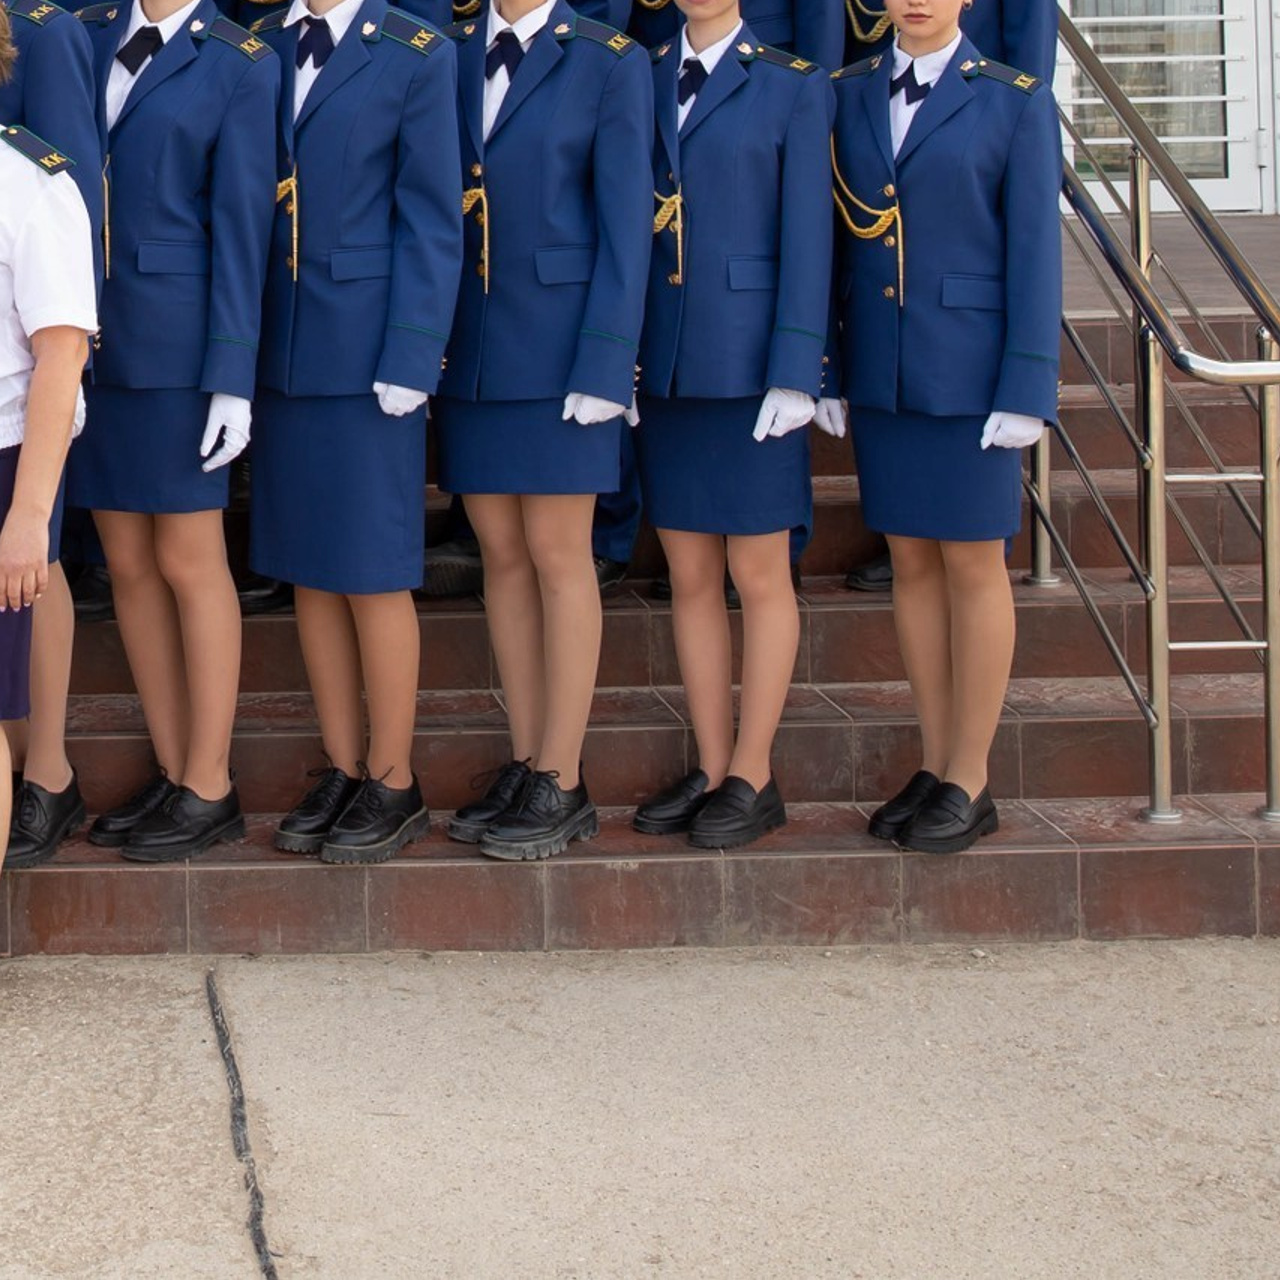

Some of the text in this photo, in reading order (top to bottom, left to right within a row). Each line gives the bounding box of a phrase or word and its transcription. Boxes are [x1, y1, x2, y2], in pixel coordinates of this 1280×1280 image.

[29, 4, 55, 19] КК
[240, 37, 263, 53] КК
[410, 29, 435, 48] КК
[607, 34, 631, 50] КК
[40, 152, 67, 168] КК
